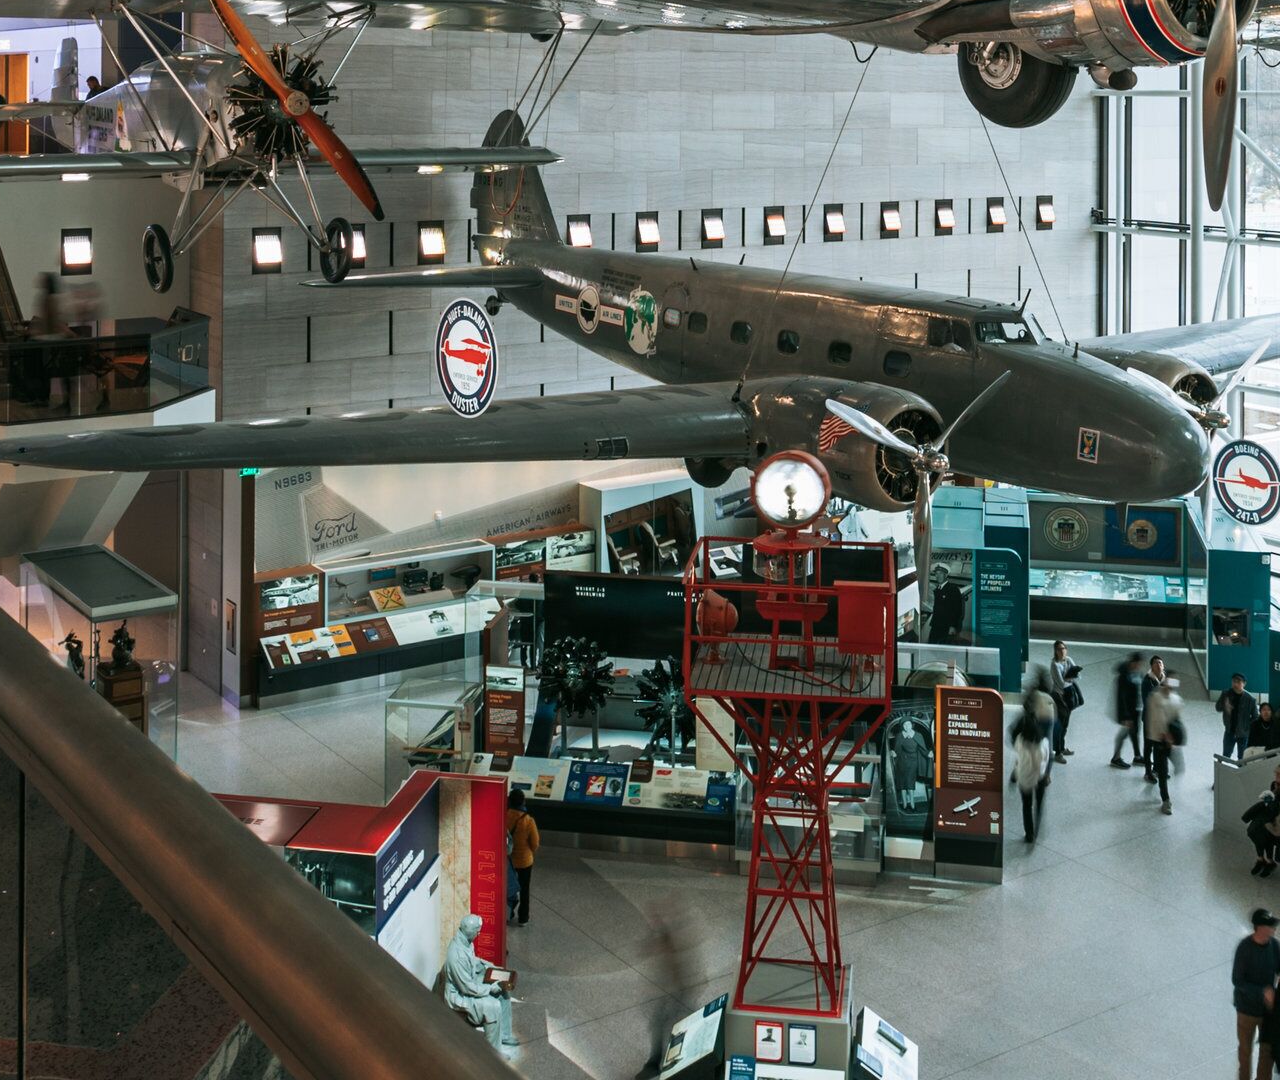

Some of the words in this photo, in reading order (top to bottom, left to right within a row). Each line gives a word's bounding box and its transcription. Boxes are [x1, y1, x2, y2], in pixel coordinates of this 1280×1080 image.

[446, 305, 486, 331] HUFF-DALAND
[451, 391, 480, 412] DUSTER
[1234, 444, 1260, 457] BOEING
[486, 517, 531, 537] AMERICAN
[536, 504, 572, 522] AIRWAYS
[1235, 509, 1260, 524] 247-D
[312, 512, 359, 542] Ford
[316, 533, 360, 551] TRI-MOTOR
[947, 713, 969, 721] AIRLINE
[947, 721, 978, 729] EXPANSION
[947, 728, 959, 736] AND
[478, 849, 496, 884] FLY
